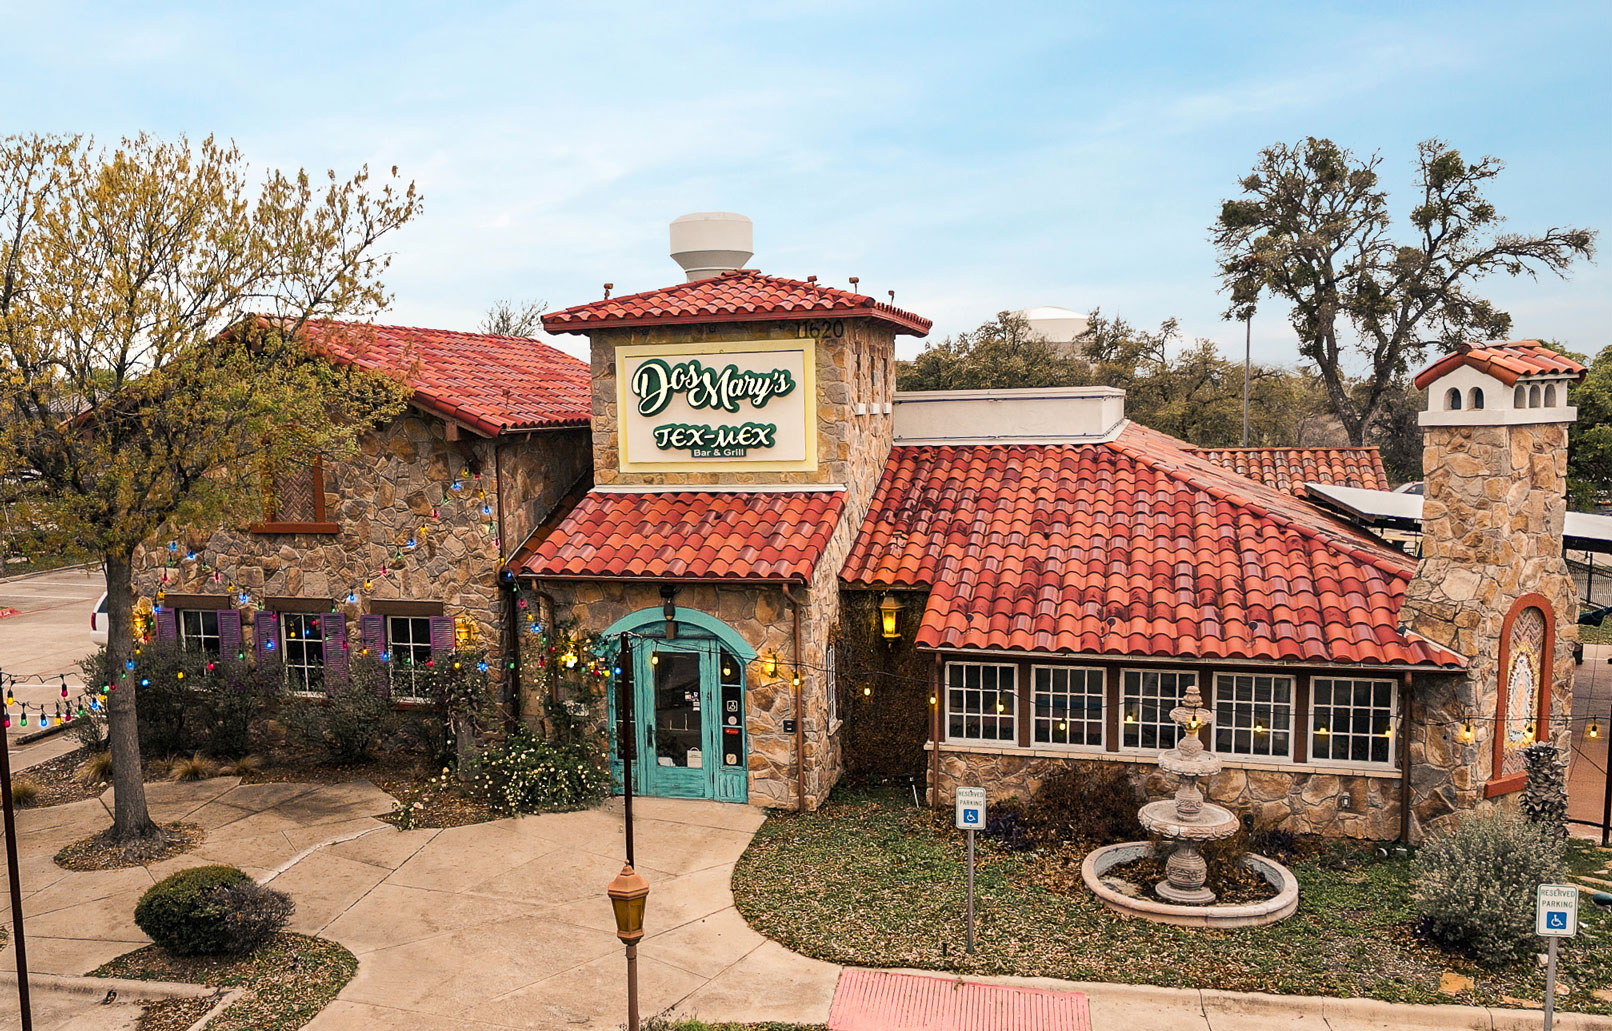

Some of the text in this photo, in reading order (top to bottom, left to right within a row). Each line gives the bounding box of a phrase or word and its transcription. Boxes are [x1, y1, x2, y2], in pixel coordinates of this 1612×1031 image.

[795, 320, 844, 338] 11620
[632, 363, 791, 414] Dos Mary's
[655, 427, 771, 447] TEX-MEX
[723, 448, 744, 456] Grill
[1540, 889, 1576, 897] RESERVED
[1542, 900, 1573, 908] PARKING
